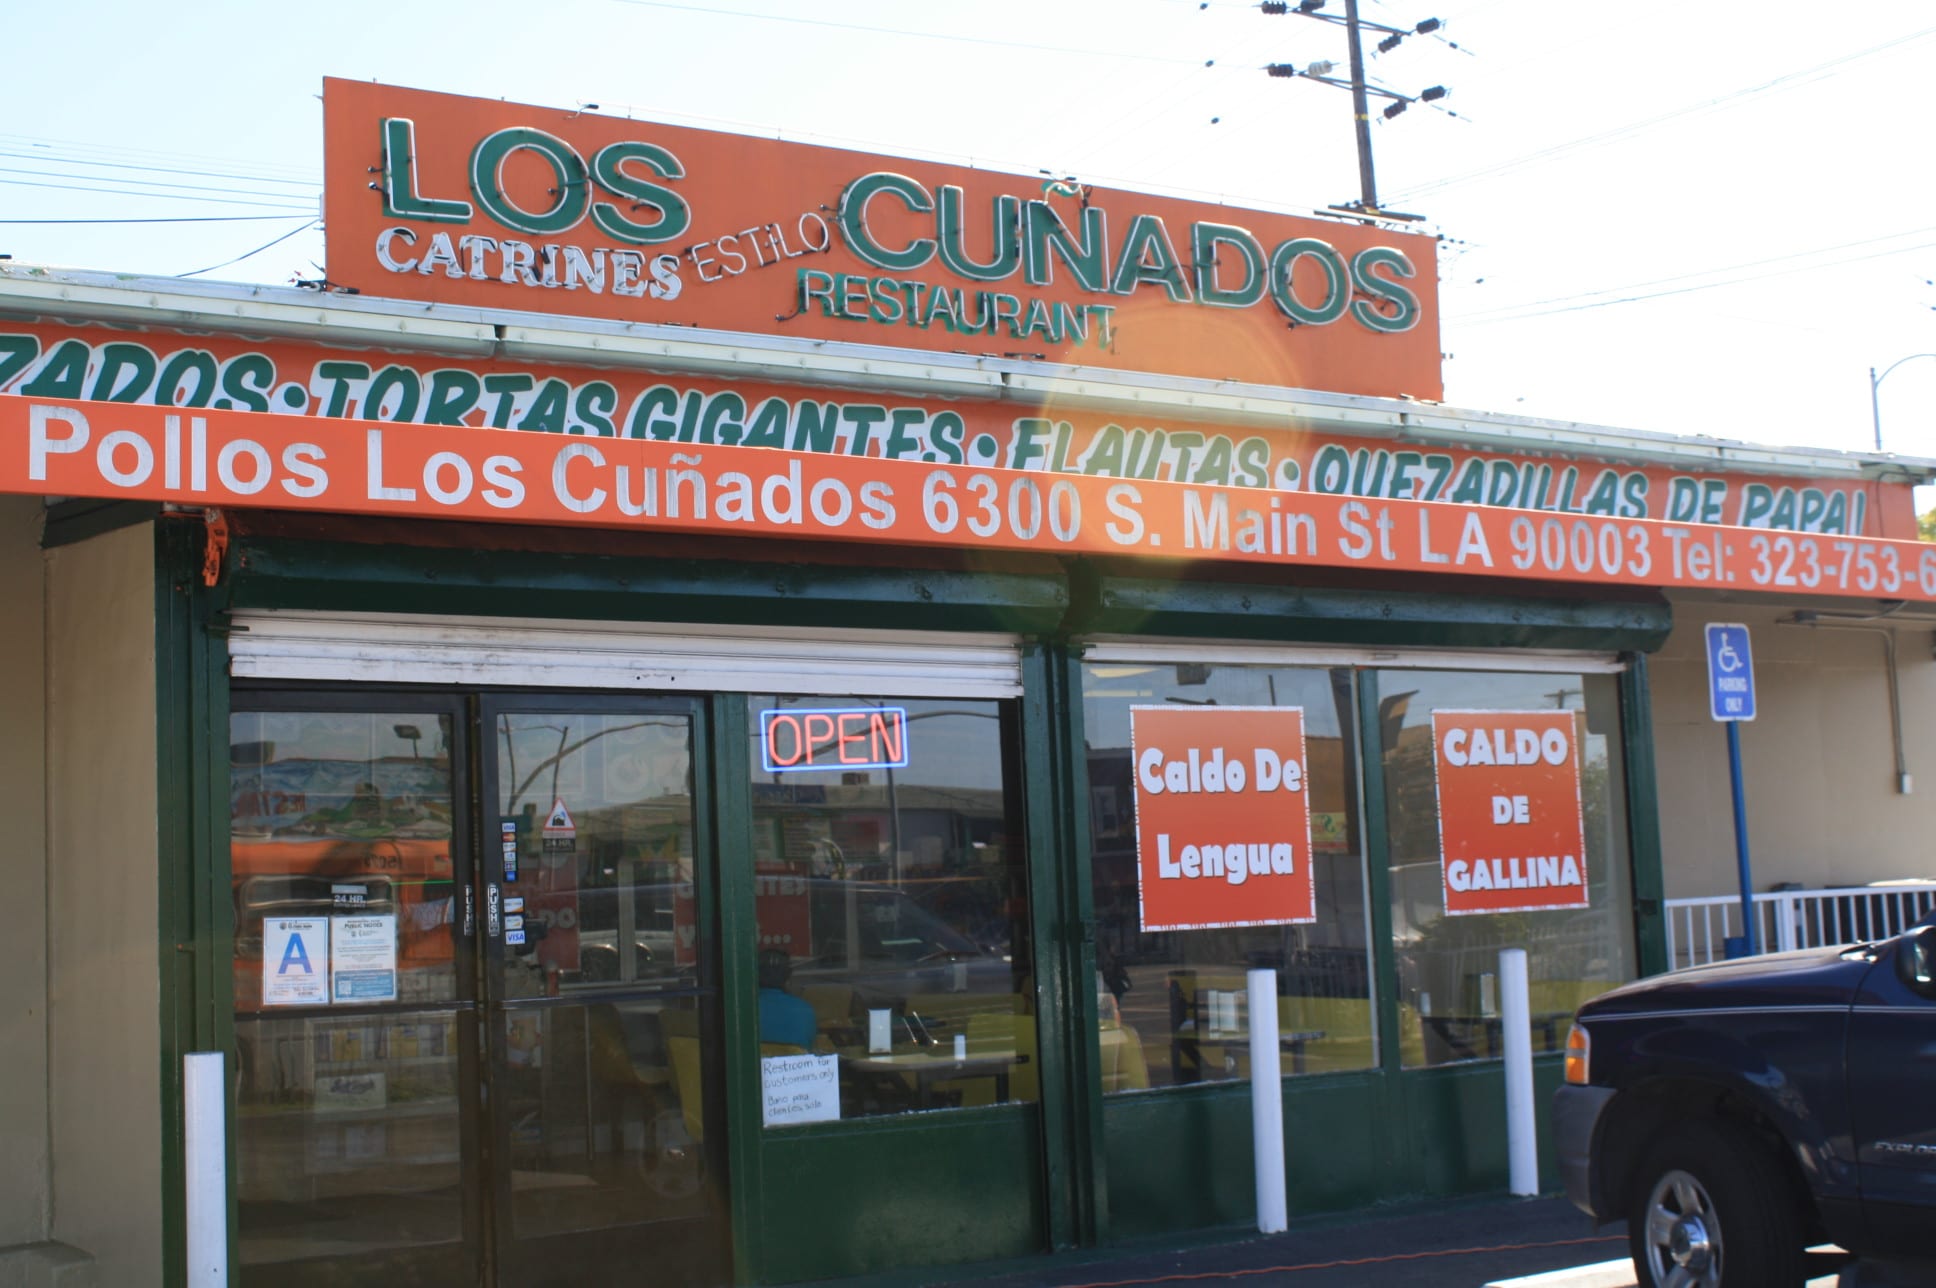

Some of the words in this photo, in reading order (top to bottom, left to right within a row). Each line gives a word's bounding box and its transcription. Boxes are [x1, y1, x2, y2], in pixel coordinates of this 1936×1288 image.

[380, 118, 691, 245] LOS
[840, 172, 1421, 334] CUÑADOS
[691, 212, 829, 282] ESTILO
[376, 227, 683, 300] CATRINES
[797, 267, 1117, 349] RESTAURANT
[311, 361, 618, 438] TORTAS
[623, 385, 965, 466] GIGANTES
[1007, 418, 1270, 489] FLAUTAS
[1666, 476, 1727, 526] DE
[28, 404, 329, 498] Pollos
[367, 429, 526, 509] Los
[552, 443, 896, 530] Cuñados
[922, 470, 1081, 543] 6300
[1105, 484, 1161, 546] S.
[1184, 490, 1317, 556] Main
[1338, 502, 1396, 561] St
[1420, 508, 1494, 567] LA
[1510, 517, 1651, 578] 90003
[1662, 527, 1736, 582] Tel:
[768, 713, 902, 766] OPEN
[1443, 728, 1568, 766] CALDO
[1139, 747, 1246, 794] Caldo
[1254, 748, 1302, 792] De
[1492, 795, 1530, 824] DE
[1157, 834, 1294, 885] Lengua
[1447, 855, 1582, 892] GALLINA
[490, 887, 498, 922] PUSH
[277, 932, 313, 975] A
[508, 932, 525, 941] VISA
